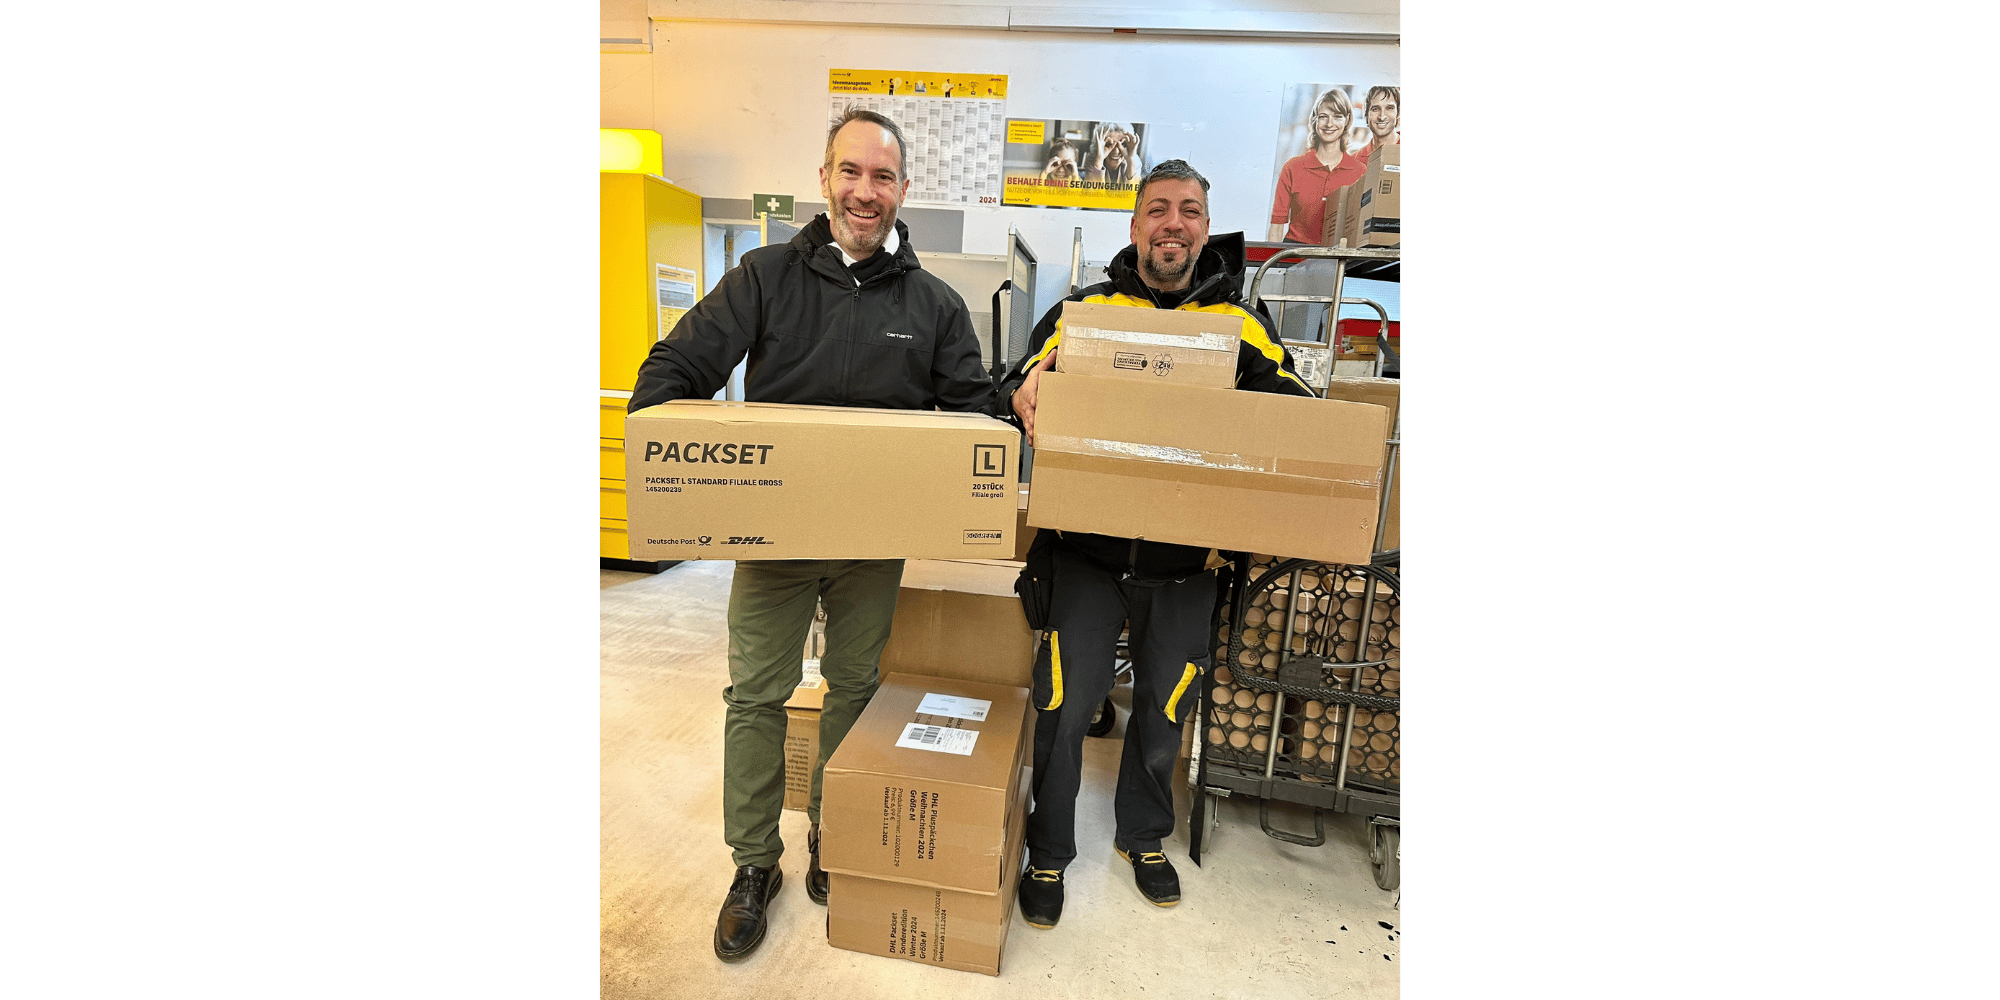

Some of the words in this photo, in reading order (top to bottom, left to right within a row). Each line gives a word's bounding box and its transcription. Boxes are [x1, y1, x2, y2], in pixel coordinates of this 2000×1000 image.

[1007, 177, 1043, 186] BEHALTE
[1044, 179, 1069, 188] DEINE
[1069, 180, 1121, 191] SENDUNGEN
[1122, 183, 1133, 191] IM
[644, 441, 774, 465] PACKSET
[984, 451, 996, 470] L
[645, 477, 680, 485] PACKSET
[687, 478, 728, 486] STANDARD
[758, 479, 783, 487] GROSS
[982, 482, 1004, 490] STÜCK
[725, 536, 769, 545] DHL
[909, 789, 917, 813] Größe
[931, 792, 939, 808] DHL
[883, 809, 889, 817] ab
[895, 788, 904, 834] Produktnummer:
[909, 813, 916, 821] M
[918, 791, 928, 839] Weihnachten
[928, 809, 938, 860] Pluspäckchen
[917, 840, 925, 859] 2024
[890, 912, 898, 939] Packset
[899, 908, 908, 955] Sonderedition
[910, 916, 918, 934] 2024
[920, 930, 927, 938] M
[889, 940, 897, 954] DHL
[909, 934, 917, 957] Winter
[919, 938, 927, 959] Größe
